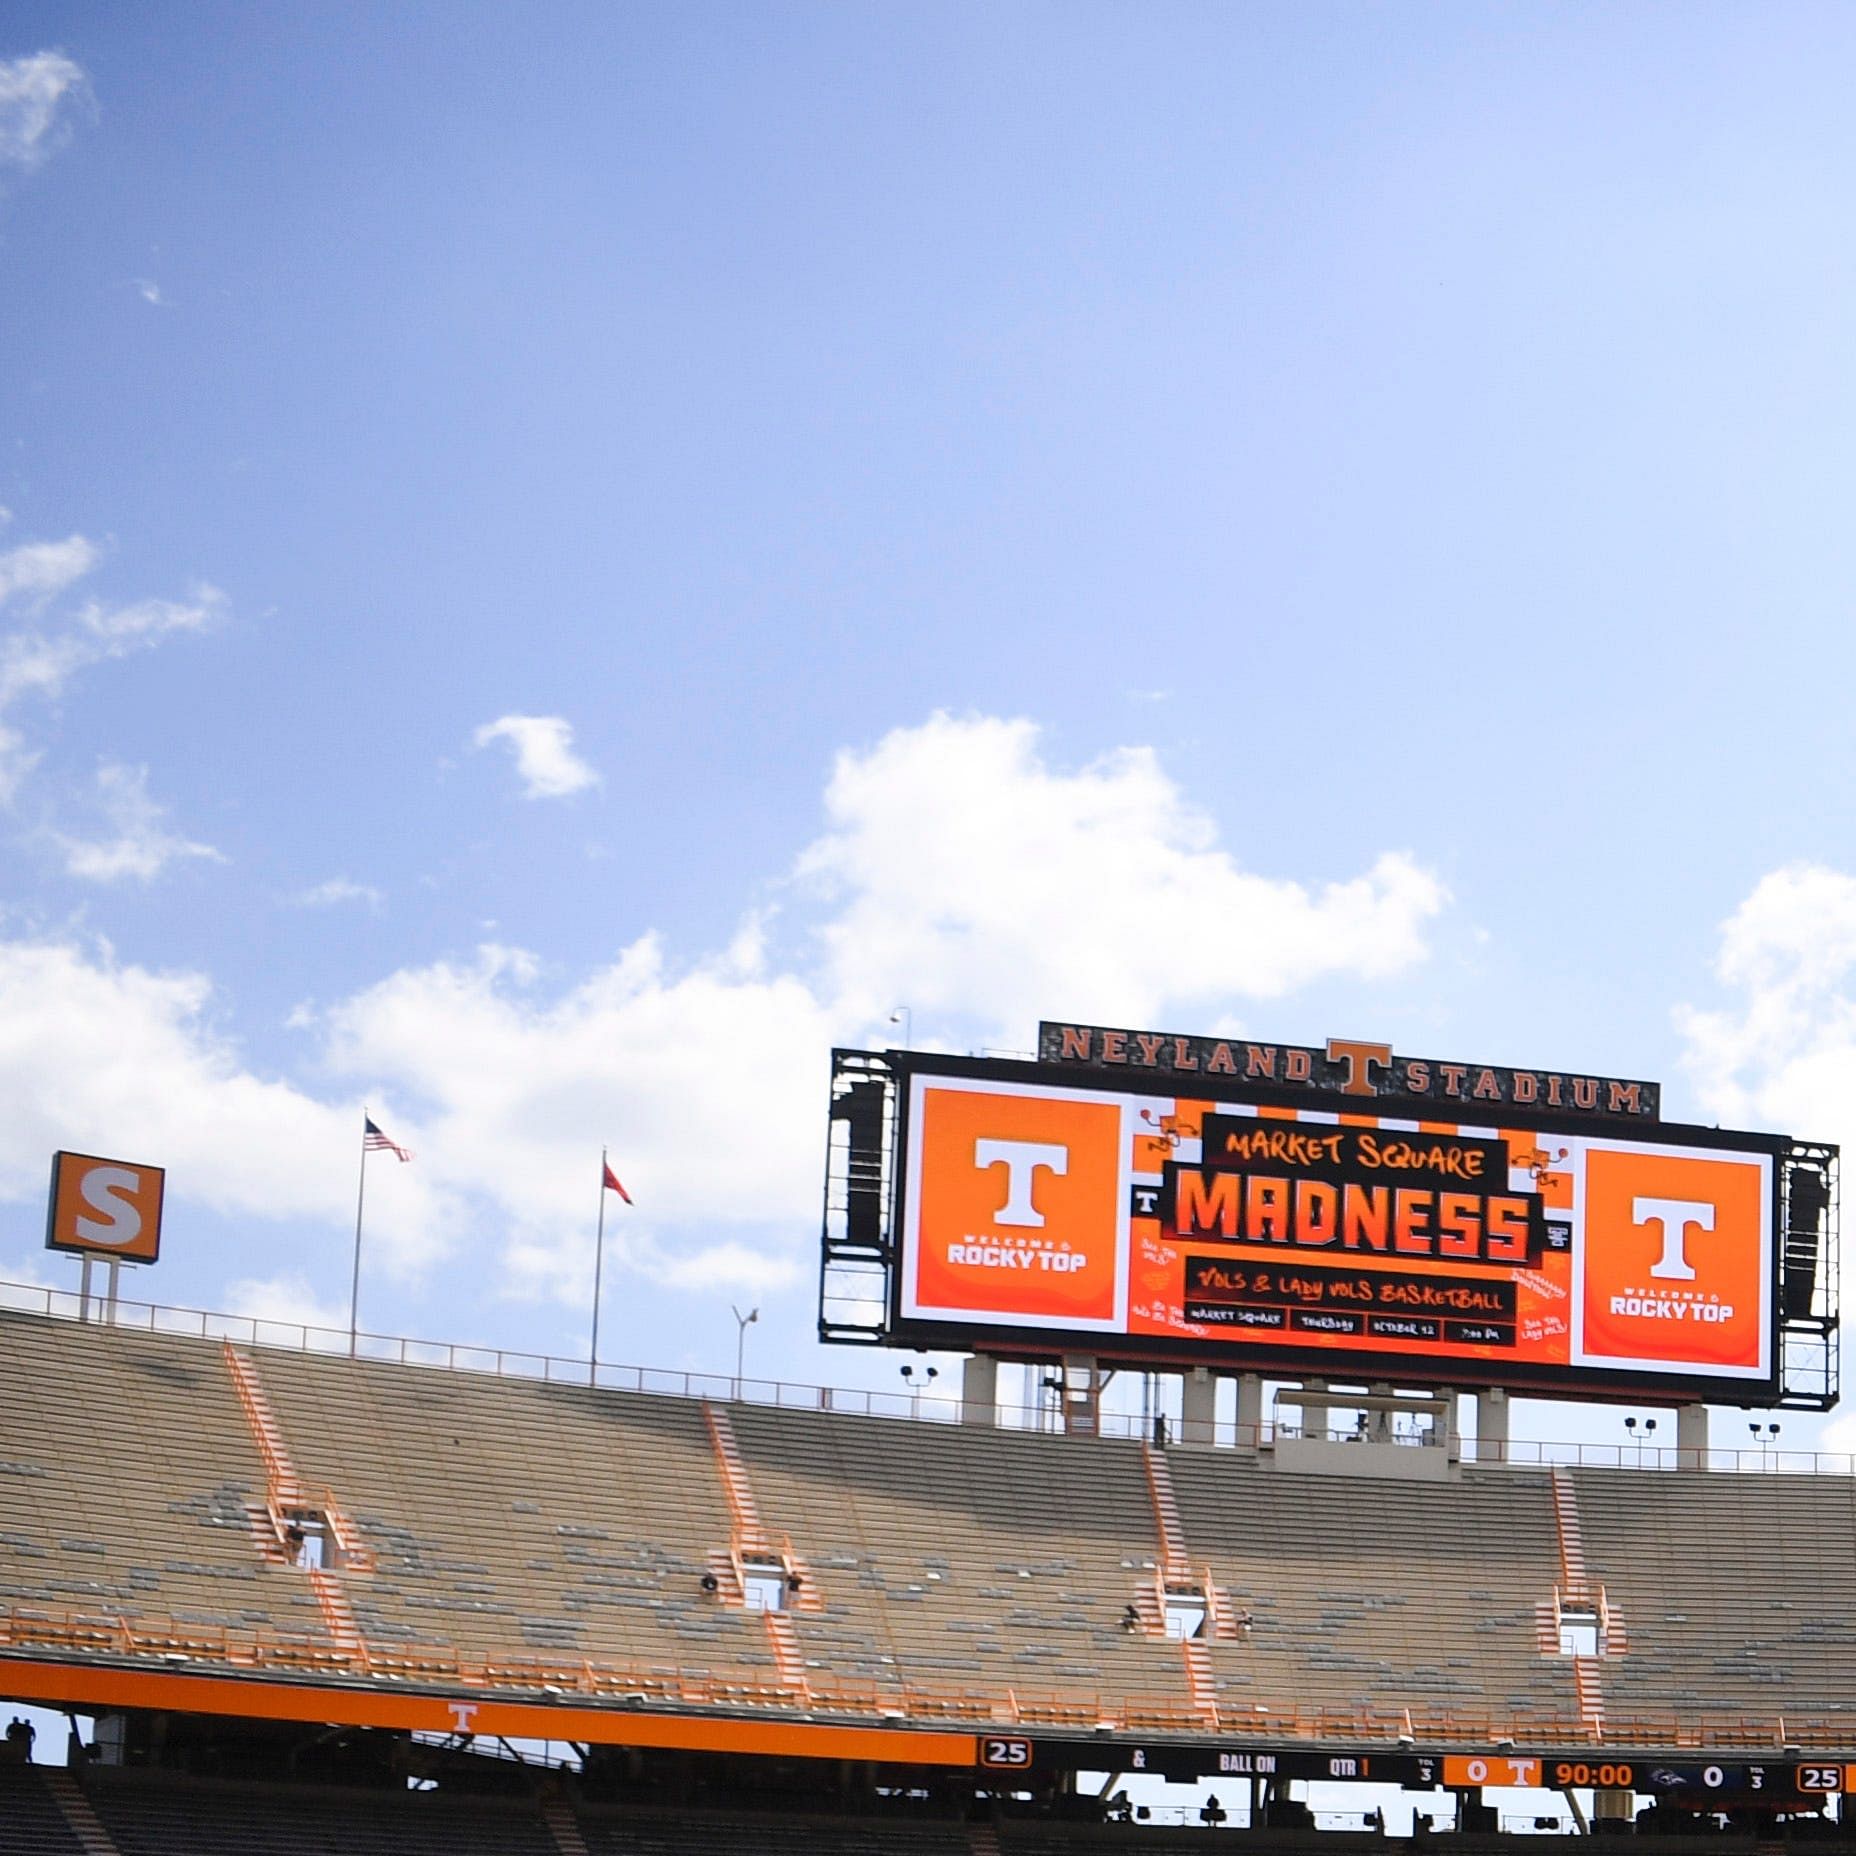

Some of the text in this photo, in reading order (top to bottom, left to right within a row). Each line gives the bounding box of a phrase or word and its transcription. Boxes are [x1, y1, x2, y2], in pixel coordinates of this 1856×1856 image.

[1061, 1027, 1312, 1082] NEYLAND
[1407, 1062, 1641, 1114] STADIUM
[1226, 1130, 1485, 1180] MARKET SQUARE
[974, 1138, 1069, 1228] T
[75, 1166, 142, 1246] S
[1176, 1169, 1530, 1262] MADNESS
[963, 1234, 1055, 1250] WELCOME
[1632, 1196, 1715, 1280] T
[947, 1243, 1087, 1272] ROCKY TOP
[1197, 1266, 1504, 1310] VOLS & LADY VOLS BASKETBALL
[1624, 1287, 1704, 1299] WELCOME
[1610, 1296, 1734, 1323] ROCKY TOP
[989, 1742, 1026, 1763] 25
[1133, 1750, 1146, 1768] &
[1219, 1753, 1277, 1773] BALL ON
[1329, 1759, 1357, 1777] QTR
[1421, 1768, 1432, 1781] 3
[1556, 1764, 1633, 1785] 90:00
[1804, 1769, 1838, 1788] 25
[1752, 1776, 1762, 1789] 3
